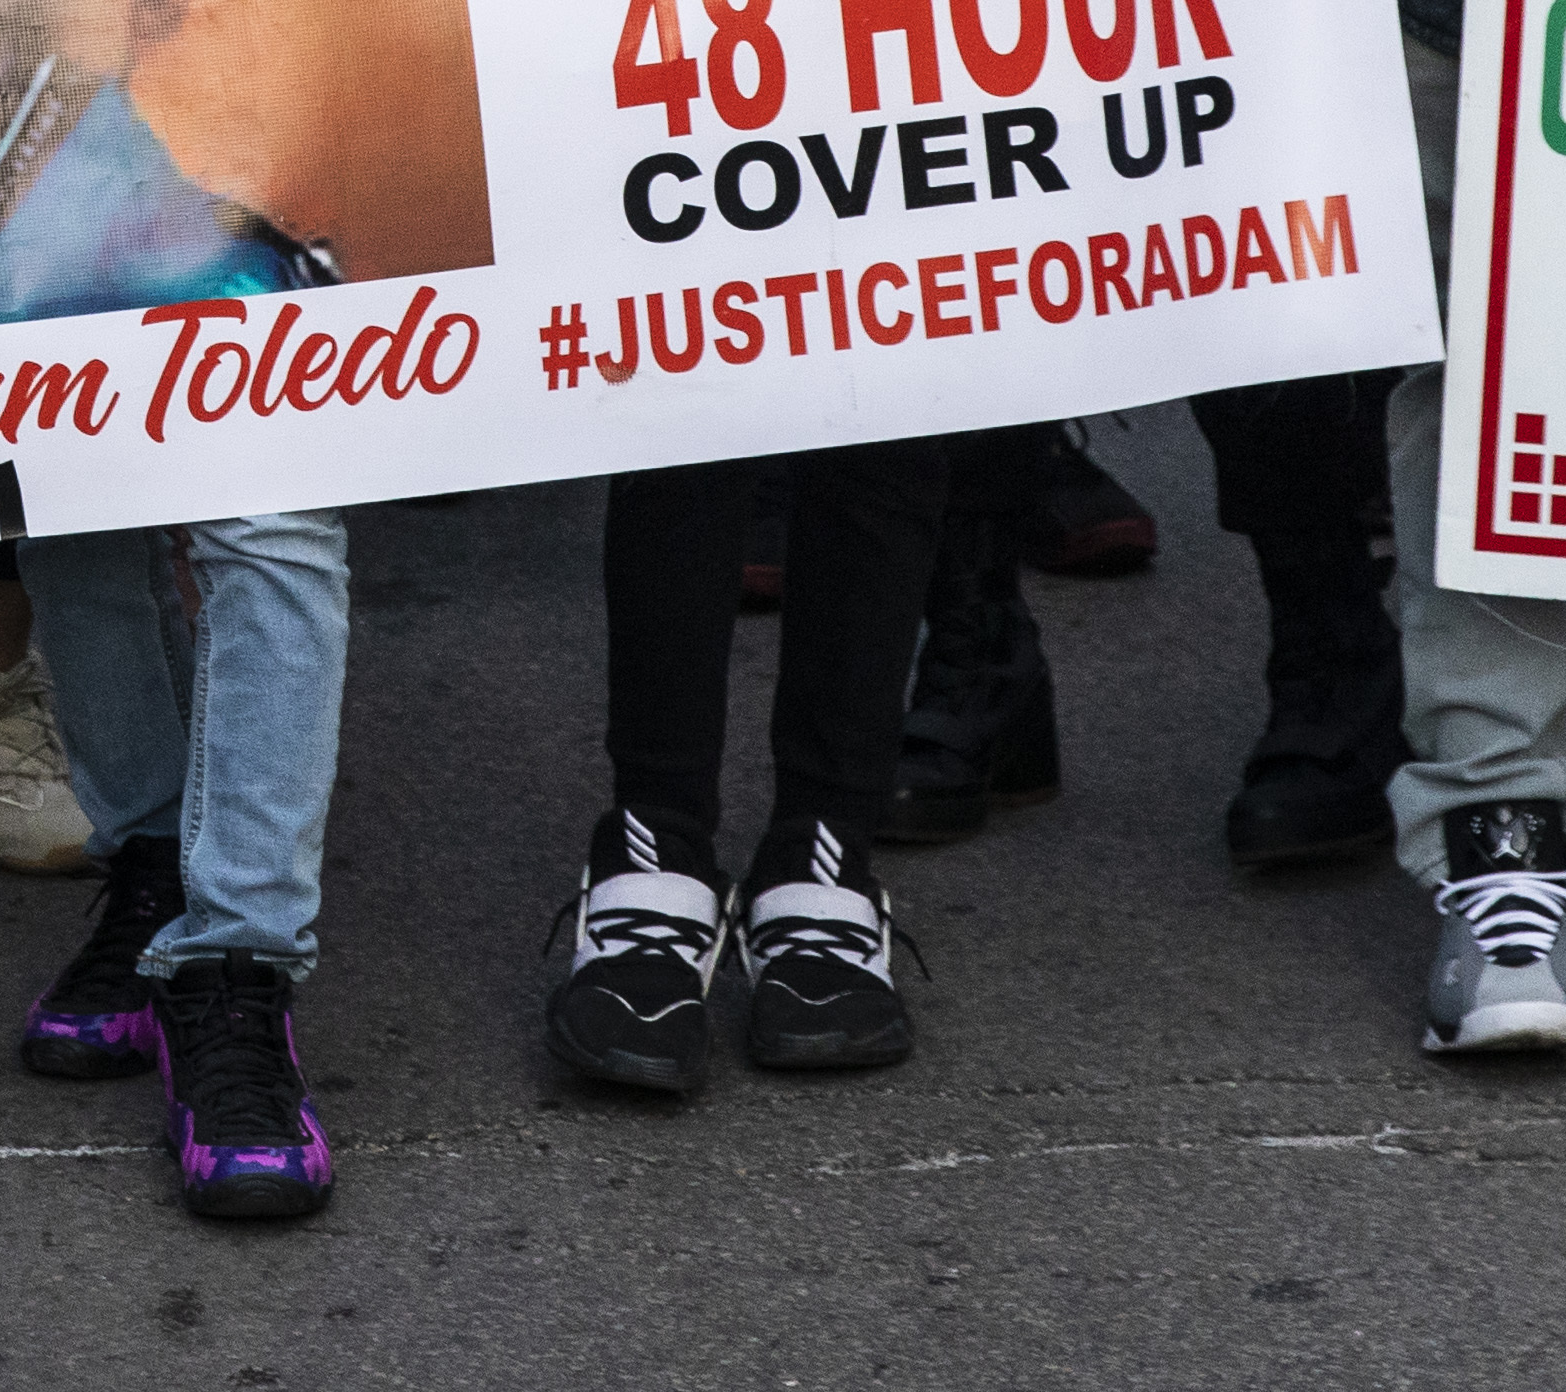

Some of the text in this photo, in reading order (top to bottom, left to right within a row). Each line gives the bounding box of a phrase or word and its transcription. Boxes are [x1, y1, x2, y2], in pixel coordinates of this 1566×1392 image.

[624, 76, 1234, 243] COVER UP
[142, 287, 479, 442] Toledo
[540, 195, 1357, 390] #JUSTICEFORADAM
